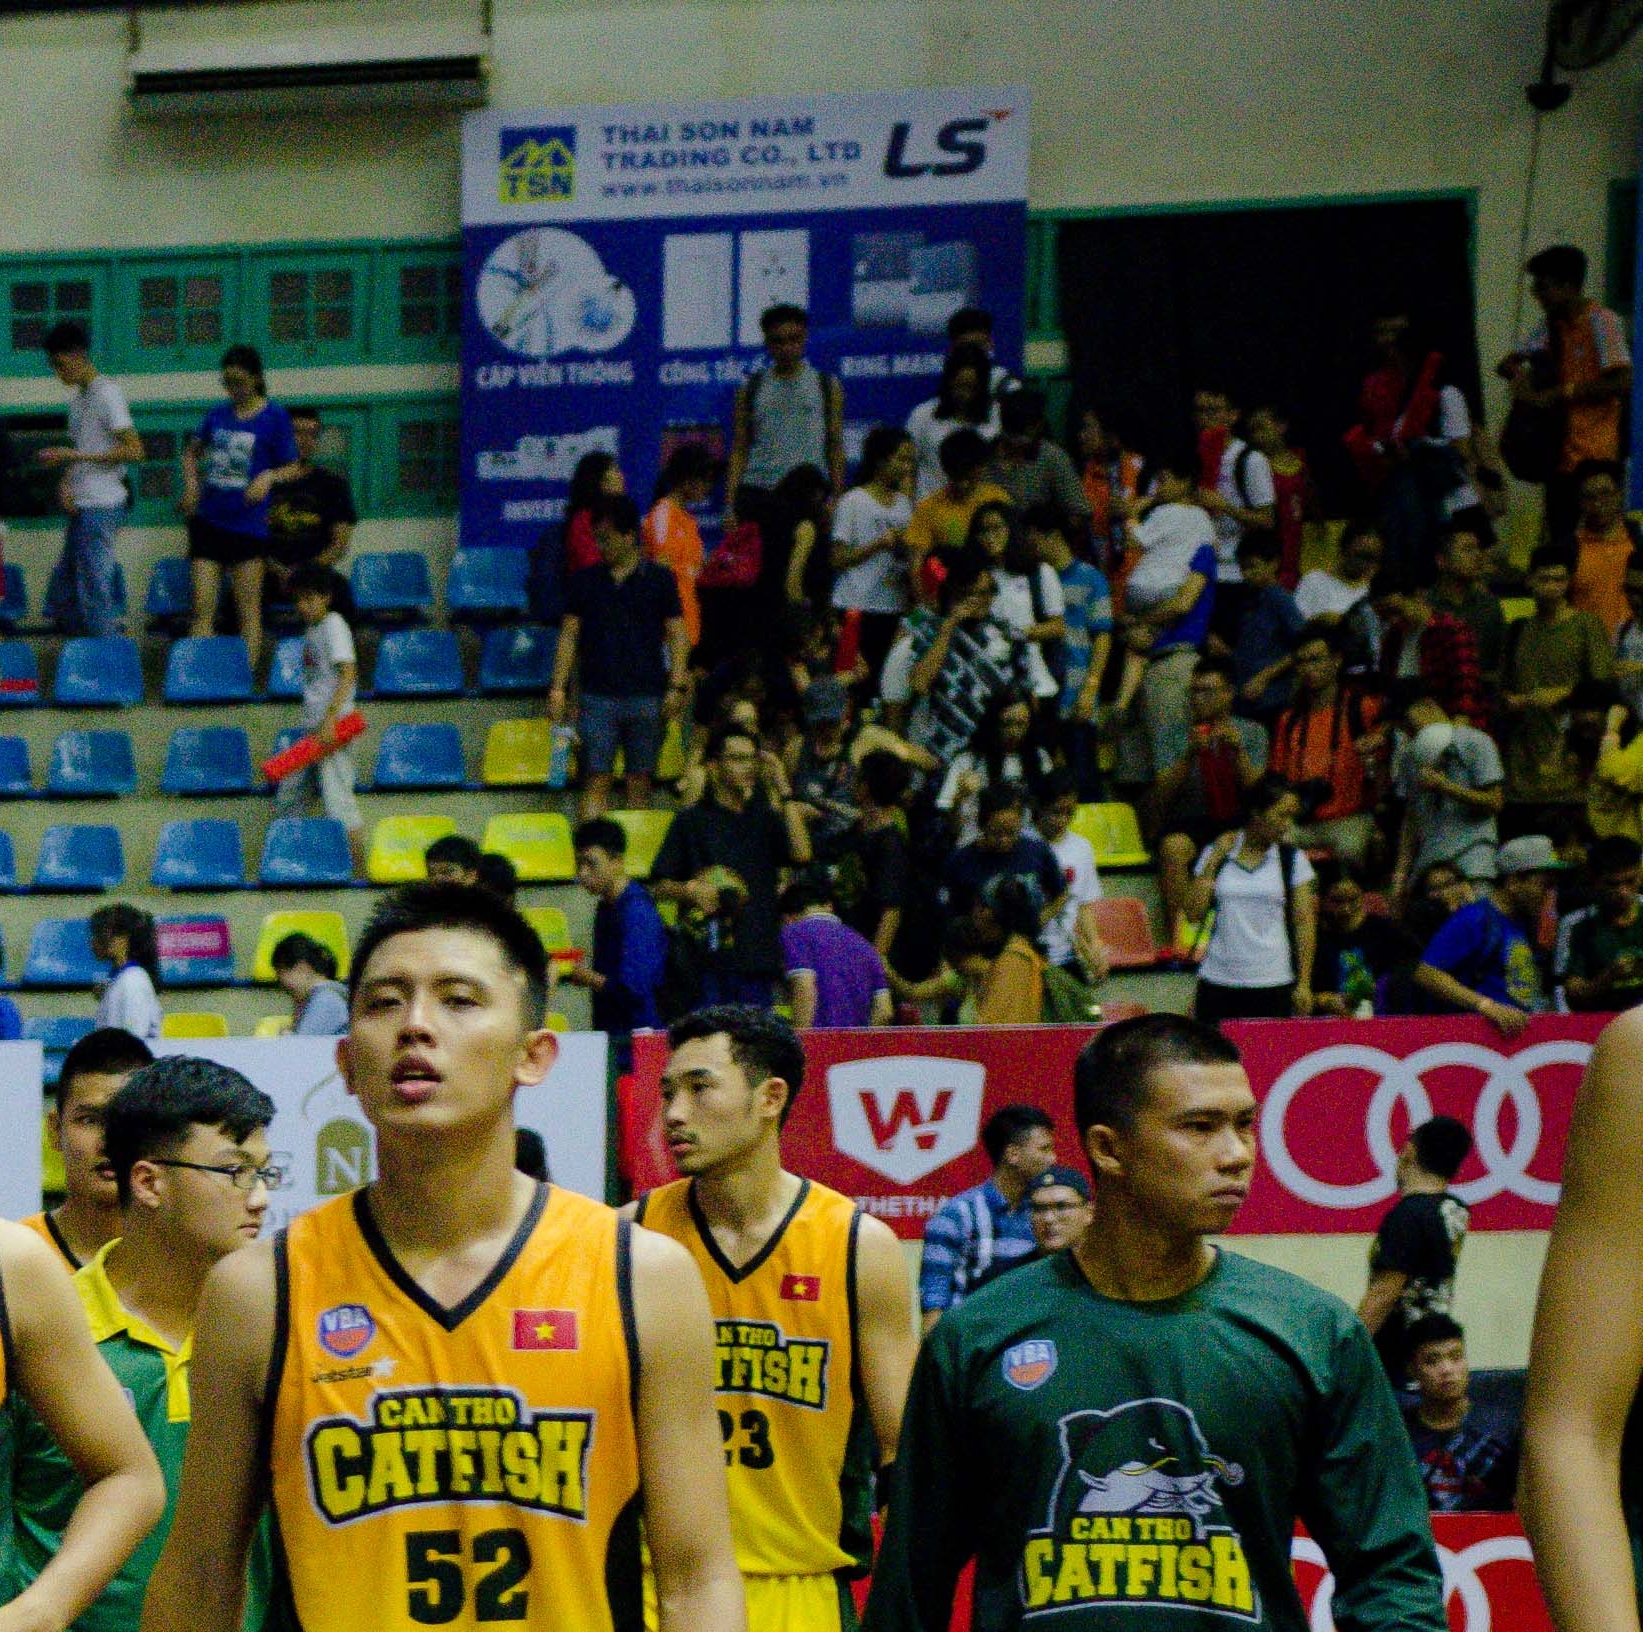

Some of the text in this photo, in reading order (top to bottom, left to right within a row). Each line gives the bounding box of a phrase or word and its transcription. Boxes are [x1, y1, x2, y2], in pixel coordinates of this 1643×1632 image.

[601, 117, 814, 145] THAI SON NAM
[600, 148, 730, 171] TRADING
[807, 141, 862, 163] LTD
[883, 118, 991, 178] LS
[503, 174, 574, 198] TSN
[322, 1308, 370, 1333] VBA
[378, 1397, 516, 1427] CAN THO
[313, 1419, 588, 1518] CATFISH
[1070, 1517, 1192, 1541] CAN THO
[405, 1527, 532, 1624] 52
[1024, 1535, 1254, 1613] CATFISH
